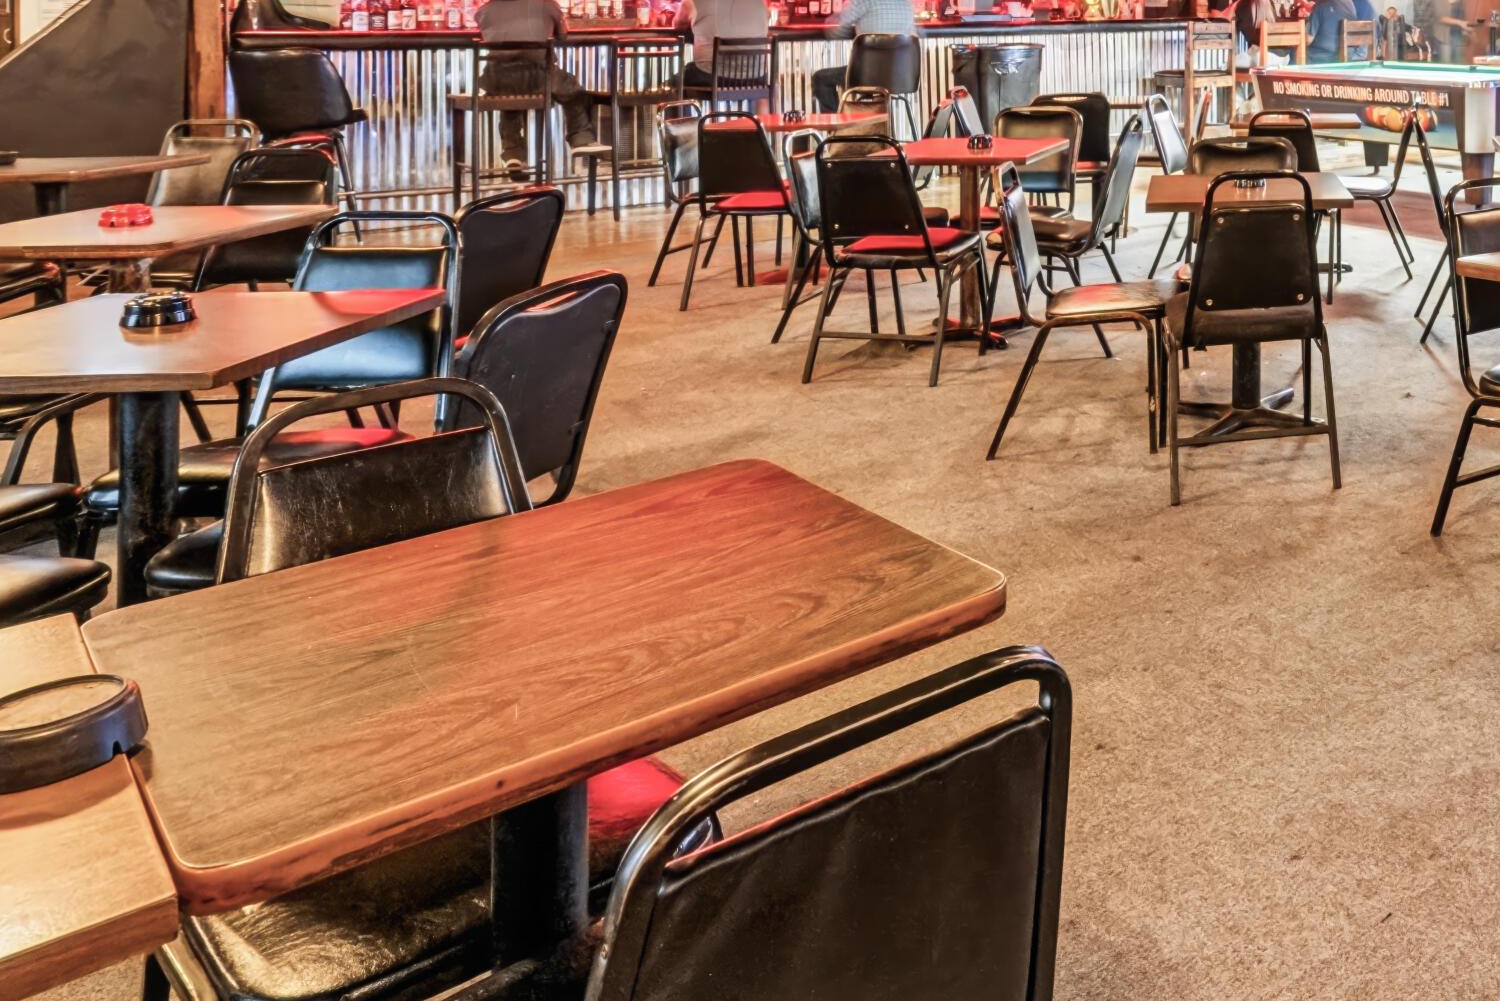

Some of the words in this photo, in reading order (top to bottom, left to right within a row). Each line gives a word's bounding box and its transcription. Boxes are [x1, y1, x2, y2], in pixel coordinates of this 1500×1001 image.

[1273, 81, 1285, 95] NO
[1285, 81, 1320, 97] SMOKING
[1321, 84, 1333, 98] OR
[1333, 85, 1373, 101] DRINKING
[1374, 88, 1409, 103] AROUND
[1438, 92, 1449, 107] #1
